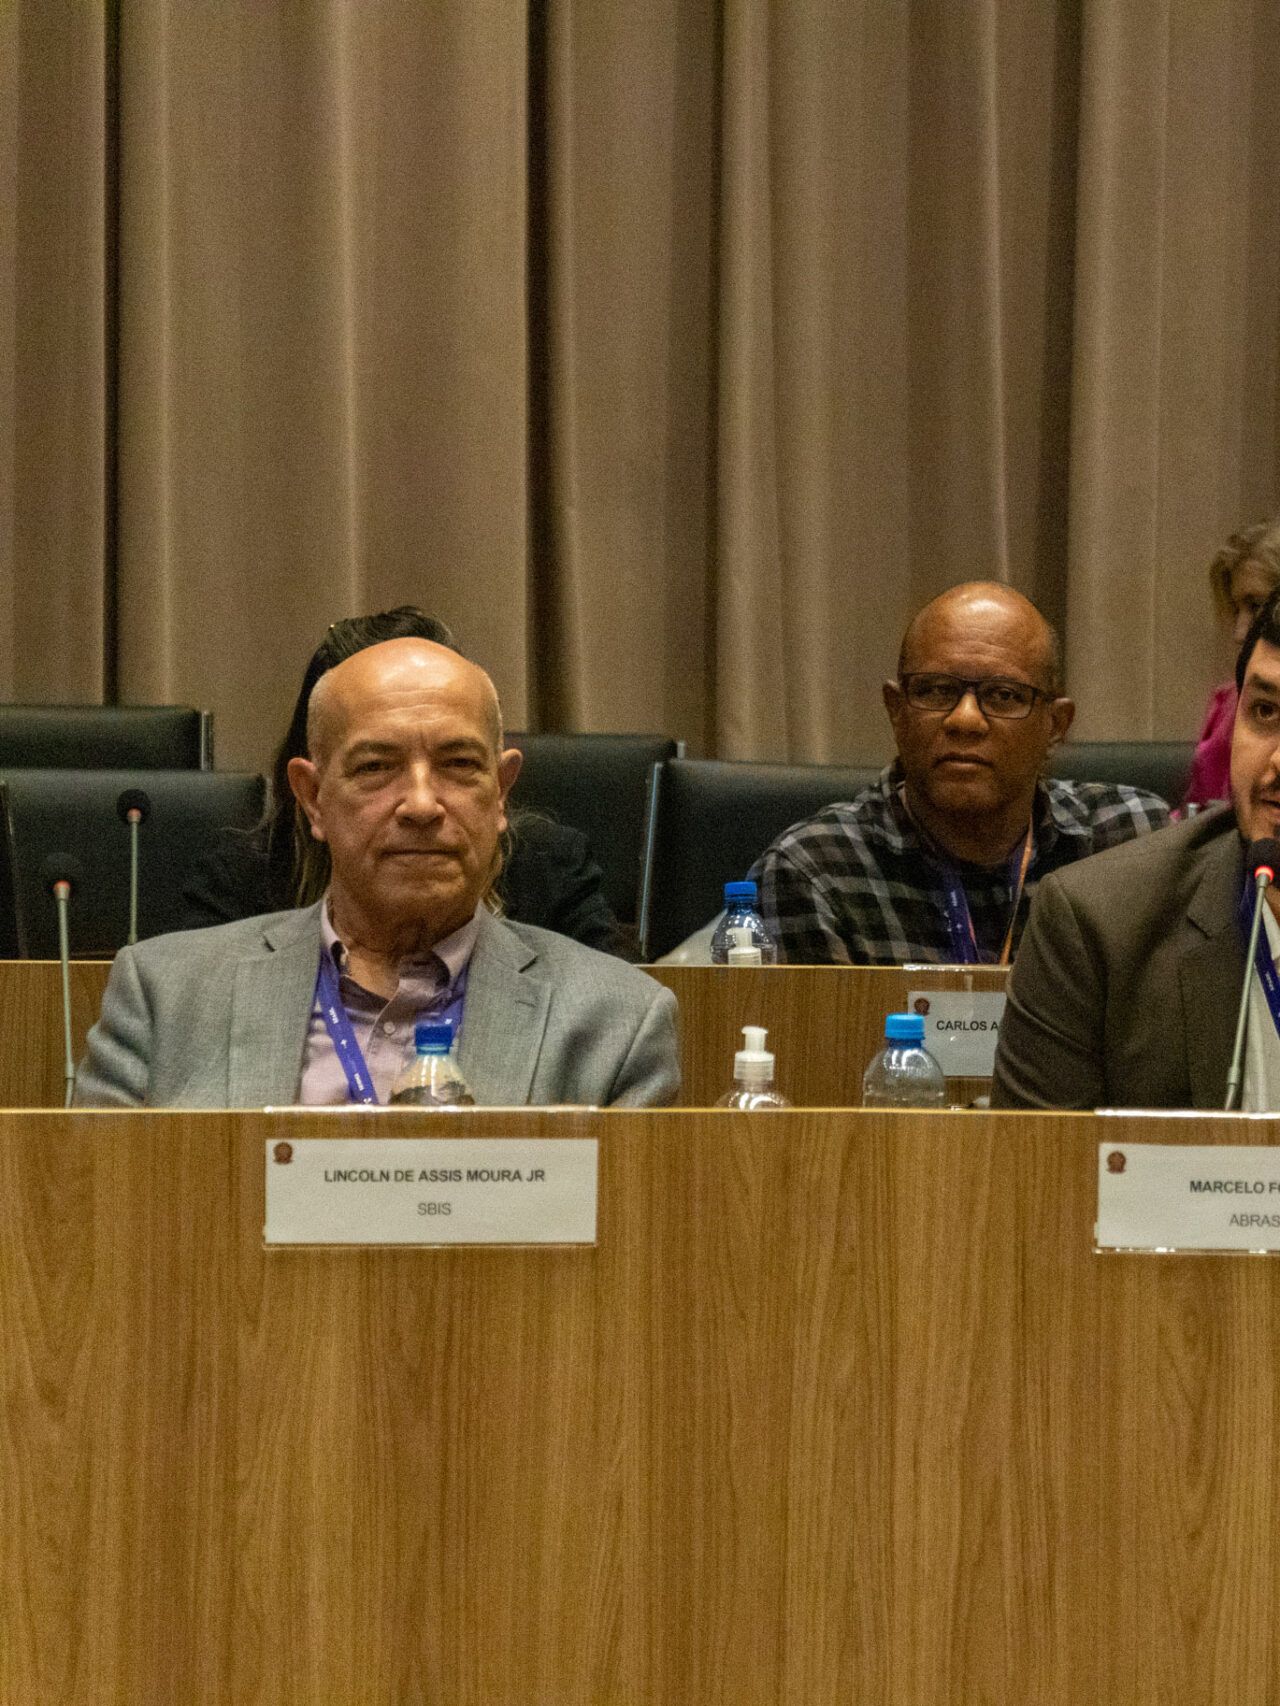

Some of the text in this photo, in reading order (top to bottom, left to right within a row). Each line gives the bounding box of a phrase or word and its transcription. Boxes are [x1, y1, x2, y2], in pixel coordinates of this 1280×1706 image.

[936, 1020, 987, 1031] CARLOS
[323, 1169, 546, 1183] LINCOLN DE ASSIS MOURA JR
[1189, 1180, 1265, 1194] MARCELO
[416, 1202, 452, 1216] SBIS
